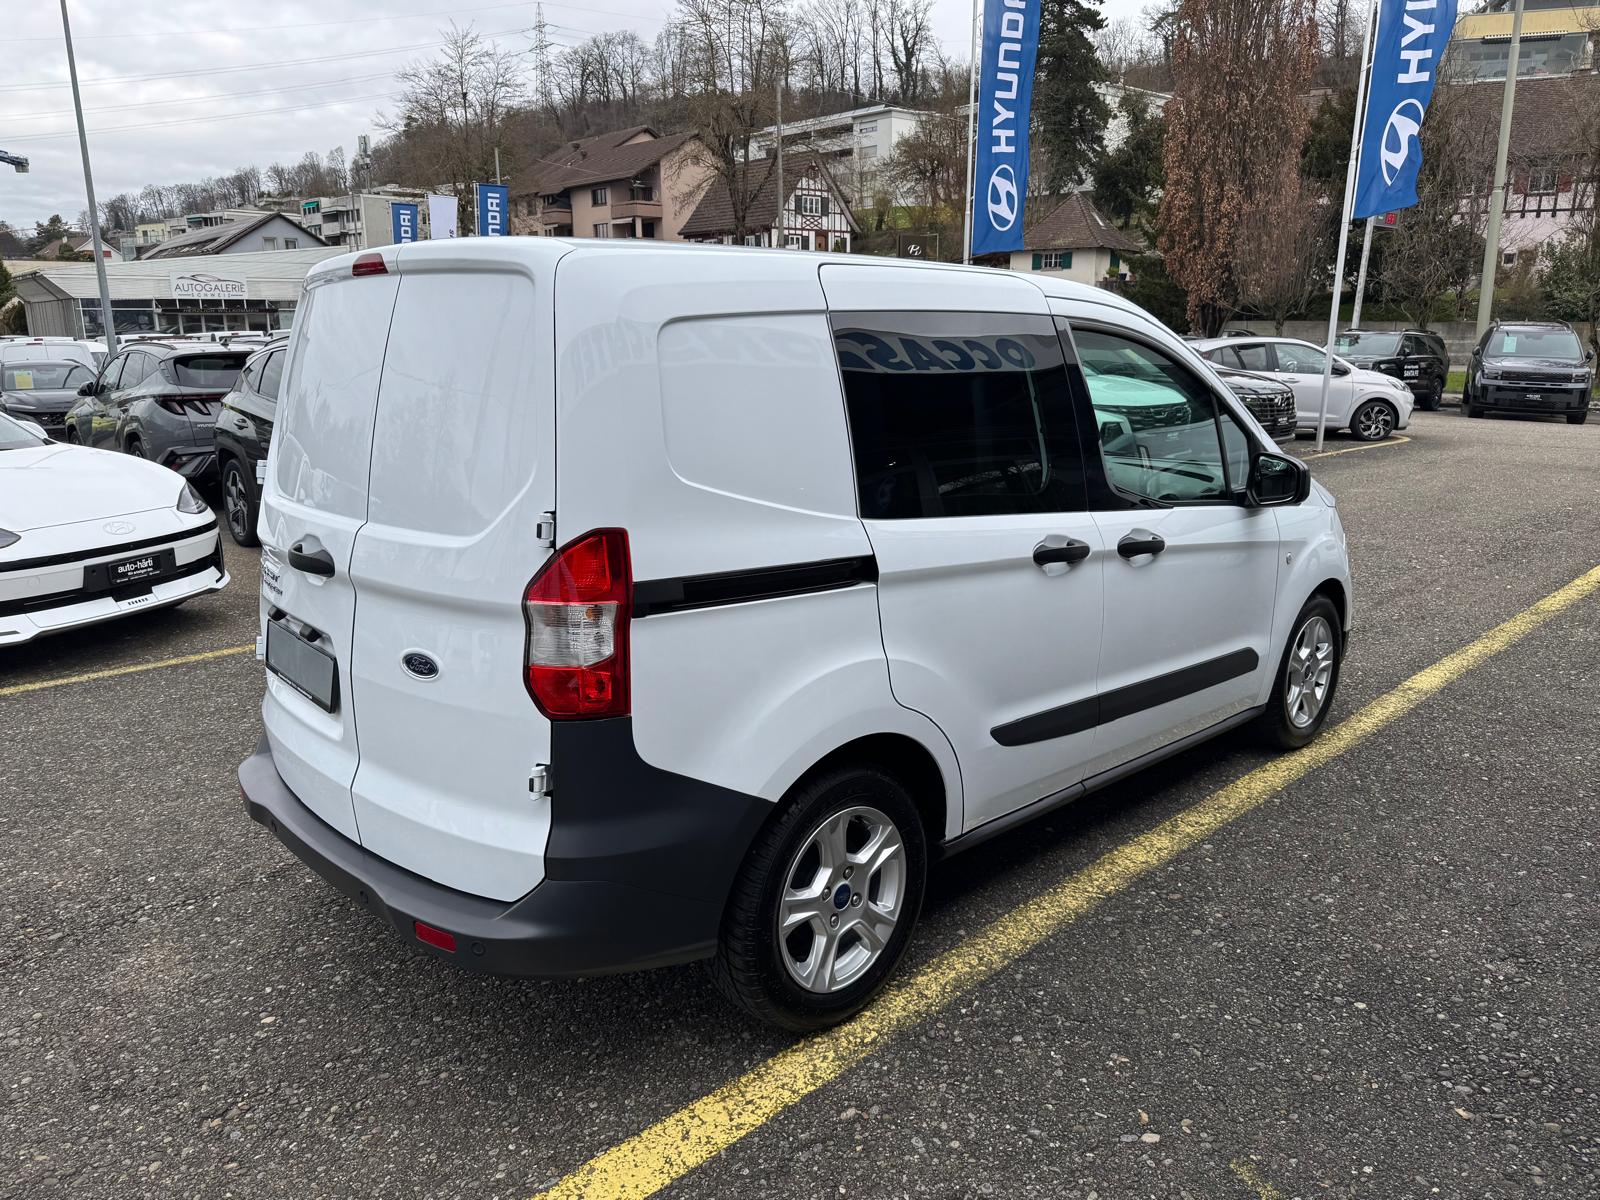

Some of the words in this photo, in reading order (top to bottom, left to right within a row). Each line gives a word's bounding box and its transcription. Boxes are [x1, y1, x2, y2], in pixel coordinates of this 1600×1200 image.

[174, 283, 246, 293] AUTOGALERIE
[118, 558, 152, 572] auto-härti
[410, 656, 430, 673] Ford
